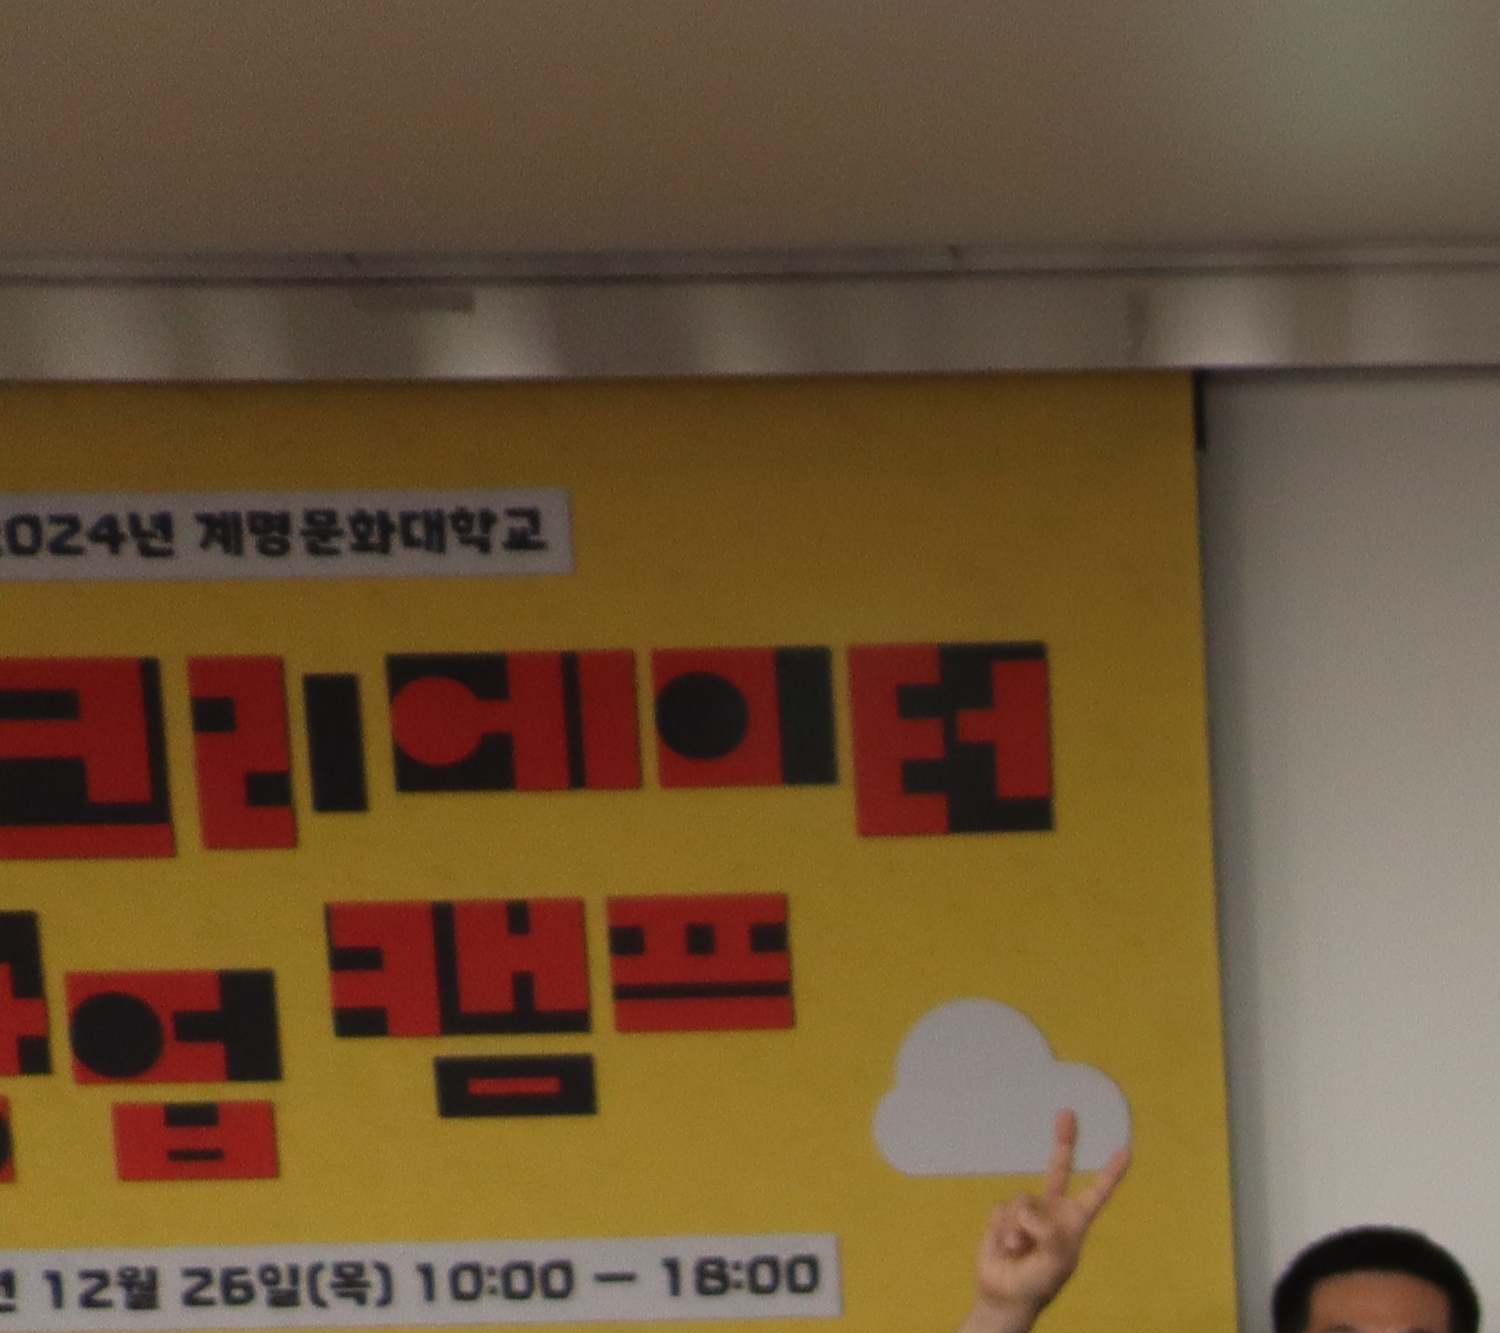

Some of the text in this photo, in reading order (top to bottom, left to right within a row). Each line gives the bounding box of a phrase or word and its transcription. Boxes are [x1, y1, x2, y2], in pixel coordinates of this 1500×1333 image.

[0, 507, 548, 558] 024년 계명문화대학교
[324, 893, 796, 1119] 캠프
[42, 1264, 162, 1311] 12월
[181, 1259, 394, 1310] 26일(목)
[414, 1258, 576, 1303] 10:00
[661, 1252, 821, 1298] 18:00
